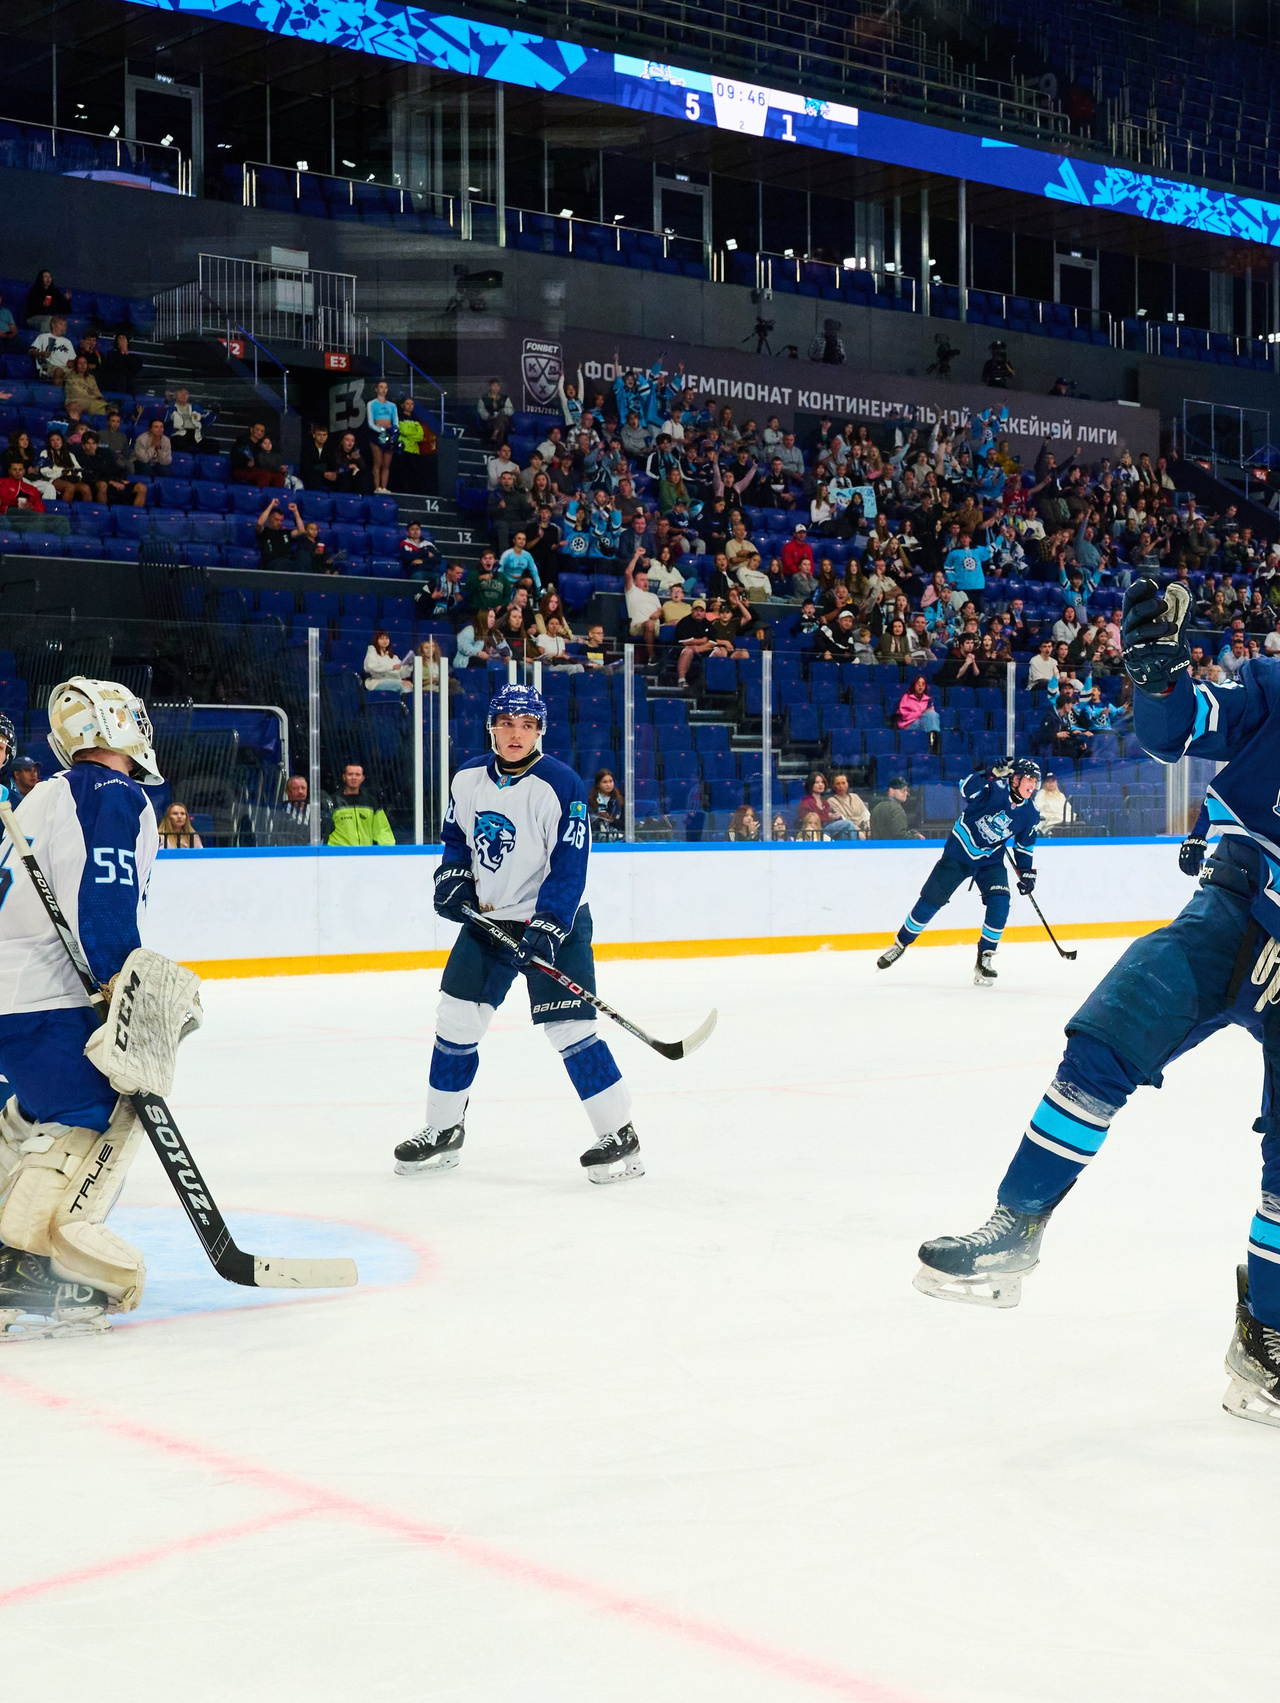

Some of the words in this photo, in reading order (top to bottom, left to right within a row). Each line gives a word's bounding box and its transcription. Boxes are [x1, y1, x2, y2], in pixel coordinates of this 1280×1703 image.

[685, 93, 700, 120] 5
[716, 82, 766, 106] 09:46
[739, 120, 745, 130] 2
[781, 114, 796, 142] 1
[526, 343, 559, 354] FONBET
[330, 356, 347, 368] E3
[329, 379, 367, 433] E3
[526, 405, 560, 415] 2025/2026
[585, 361, 669, 385] ФОН
[798, 390, 970, 428] КОНТИНЕНТЛЬНОЙ
[1076, 425, 1117, 446] ЛИГИ
[426, 500, 440, 512] 14
[458, 532, 472, 544] 13
[562, 821, 586, 849] 48
[93, 847, 135, 886] 55
[435, 869, 474, 886] BAUE
[33, 870, 59, 912] SOYUZ
[489, 927, 502, 938] ACE
[501, 934, 517, 949] prime
[529, 920, 568, 944] BAU
[114, 970, 141, 1052] CCM
[145, 1105, 212, 1211] SOYUZ
[69, 1144, 113, 1214] TRUE
